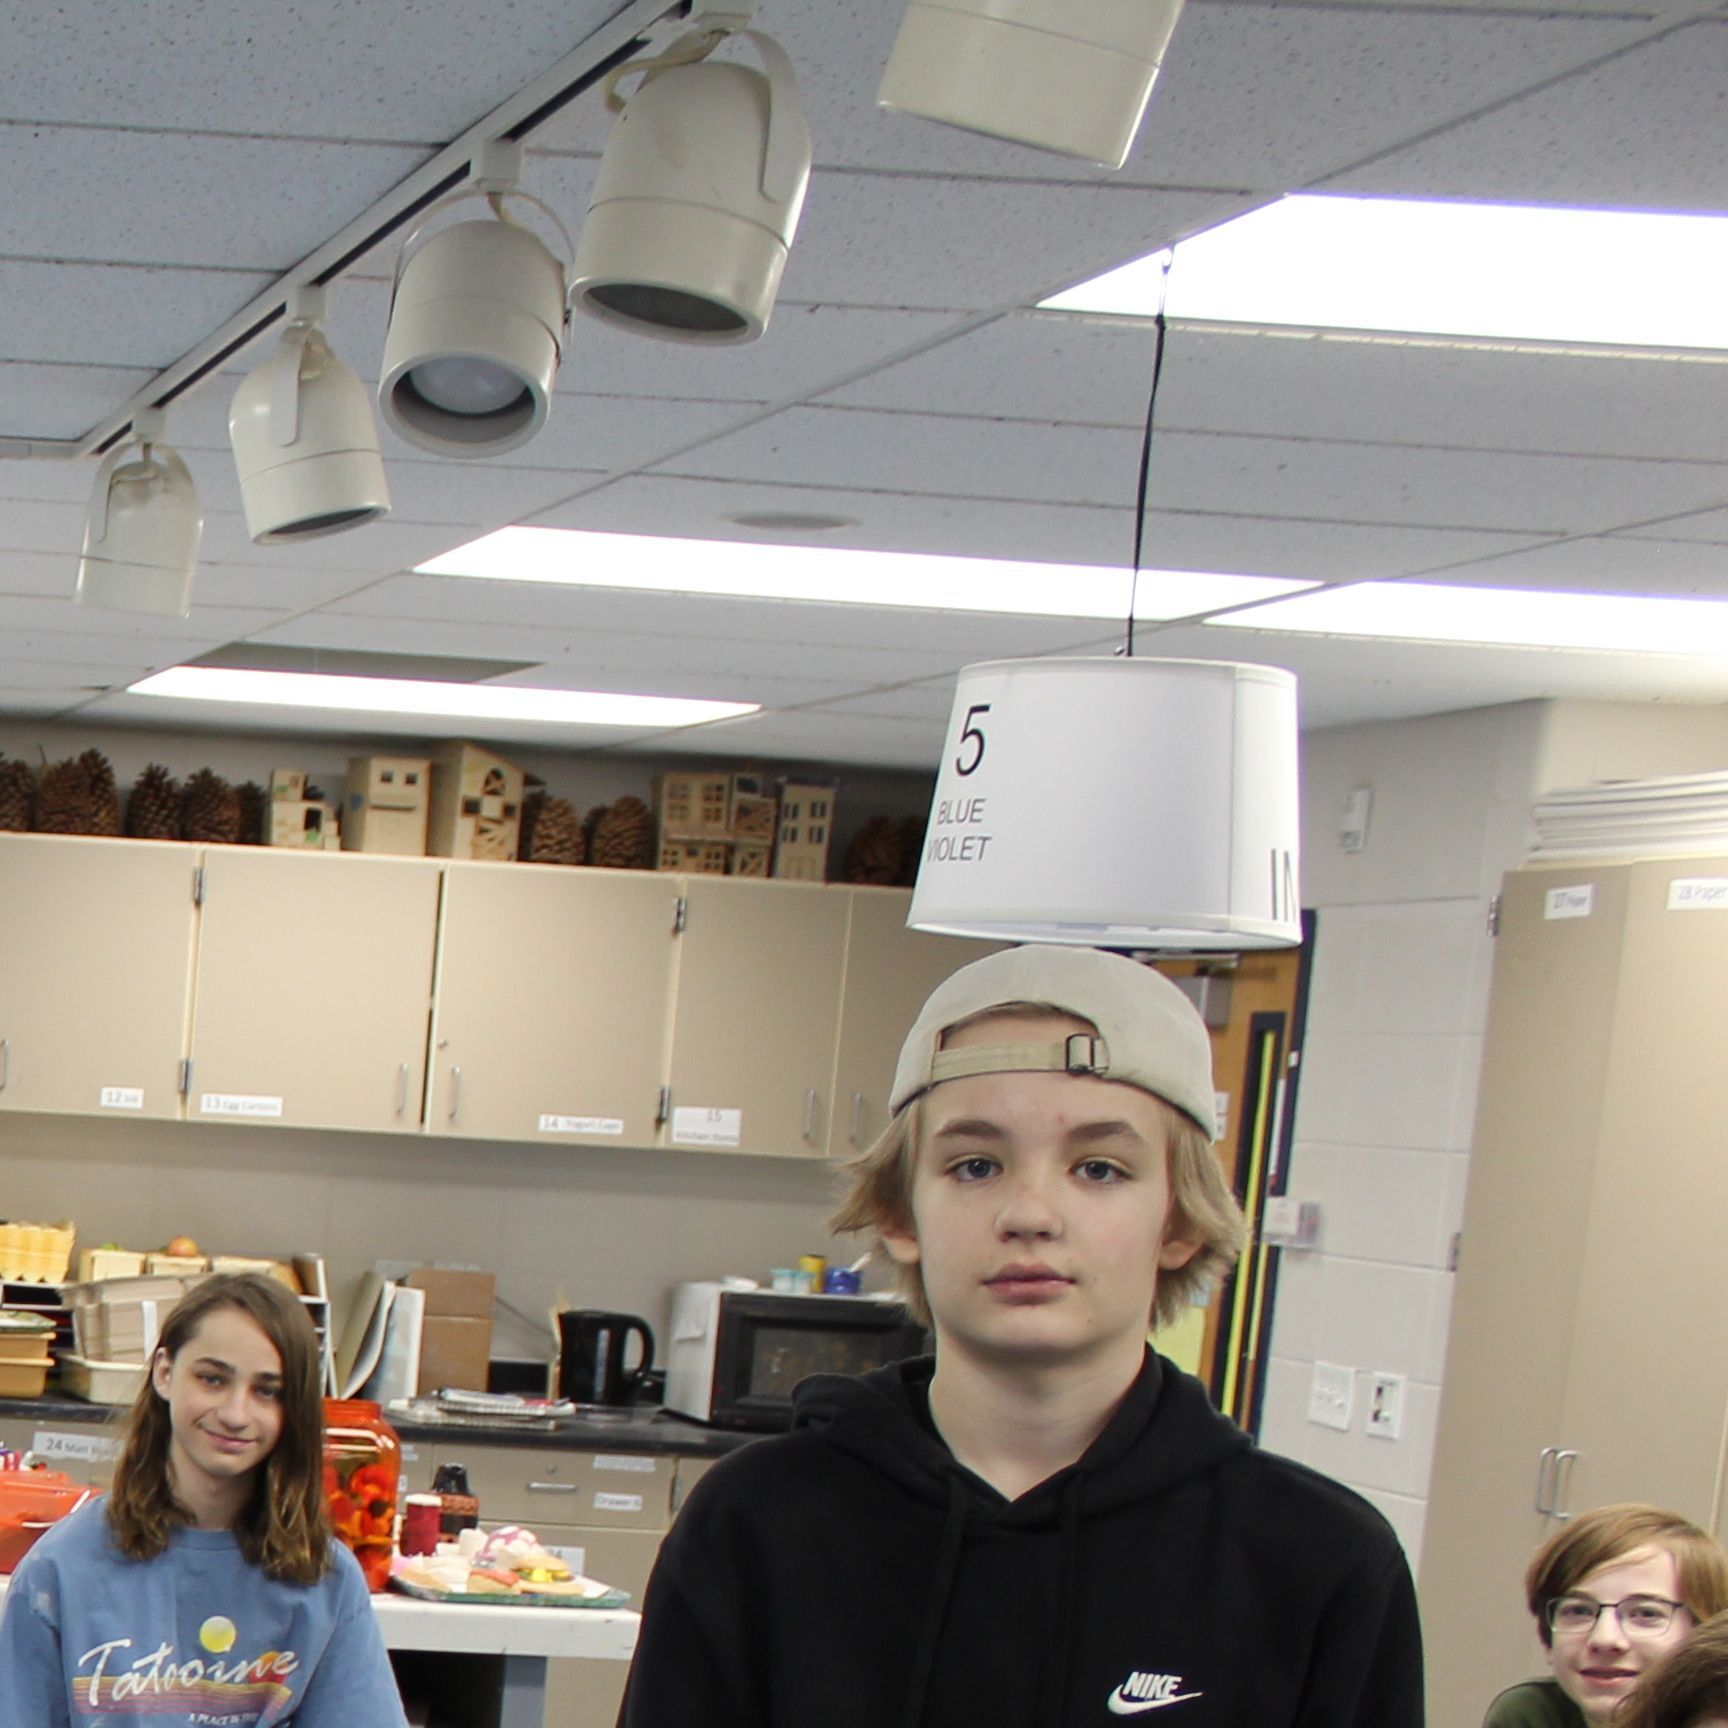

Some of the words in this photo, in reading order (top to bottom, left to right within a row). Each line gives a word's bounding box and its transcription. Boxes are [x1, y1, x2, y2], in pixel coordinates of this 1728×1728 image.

[955, 703, 991, 777] 5
[937, 798, 986, 825] BLUE
[927, 836, 993, 863] VIOLET
[46, 1438, 63, 1451] 24
[1122, 1671, 1183, 1699] NIKE
